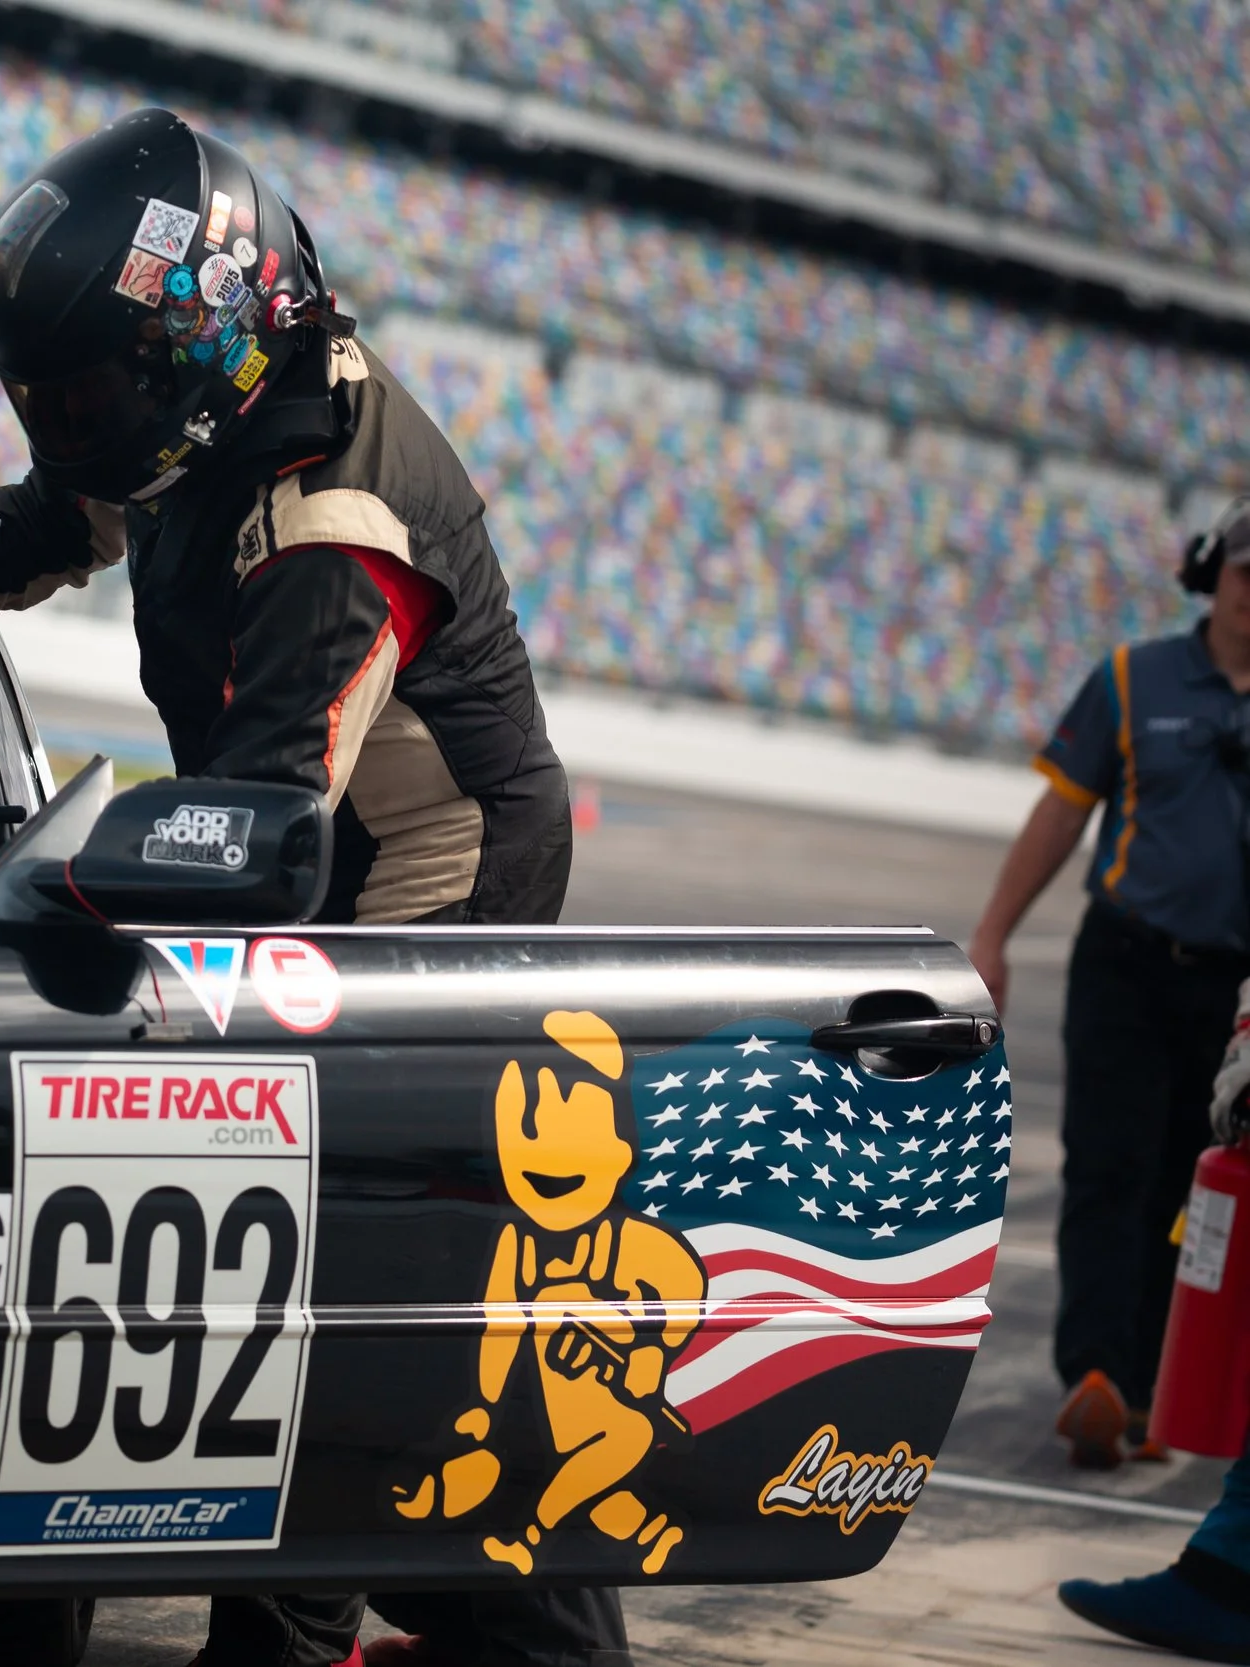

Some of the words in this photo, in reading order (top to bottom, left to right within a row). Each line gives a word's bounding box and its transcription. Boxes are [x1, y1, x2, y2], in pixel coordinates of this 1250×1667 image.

[216, 268, 240, 302] 2025
[235, 354, 260, 383] NASA
[241, 359, 265, 389] 2025
[156, 441, 193, 475] SA2020
[173, 809, 230, 829] ADD
[159, 823, 228, 848] YOUR
[41, 1077, 152, 1120] TIRE
[158, 1077, 298, 1145] RACK
[207, 1126, 274, 1145] .com
[19, 1185, 299, 1465] 692
[762, 1430, 928, 1527] Layin
[45, 1495, 238, 1537] ChampCar
[42, 1527, 141, 1540] ENDURANCE
[150, 1525, 210, 1538] SERIES
